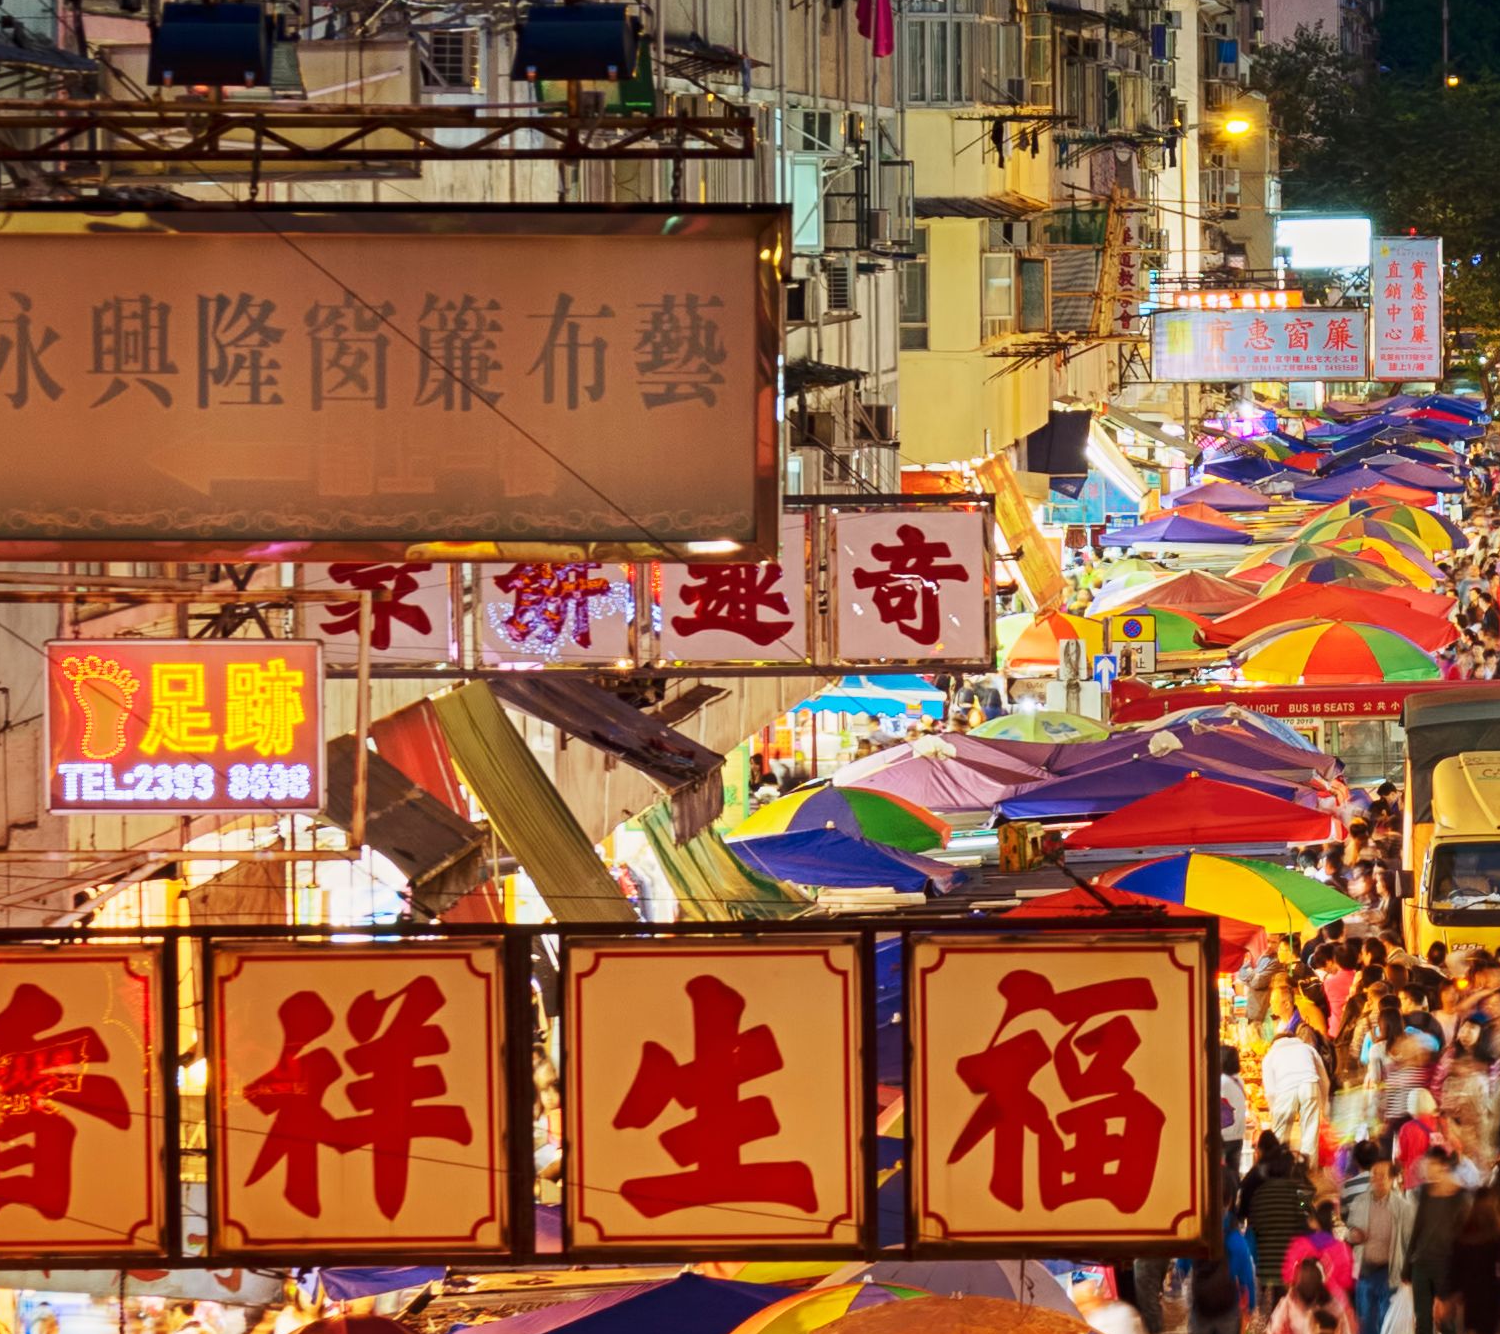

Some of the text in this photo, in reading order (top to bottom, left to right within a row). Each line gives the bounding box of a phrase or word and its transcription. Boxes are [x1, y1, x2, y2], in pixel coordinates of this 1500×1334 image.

[139, 658, 306, 756] 足跡
[1289, 703, 1308, 713] BUS
[1311, 703, 1321, 713] 16
[1323, 703, 1355, 713] SEATS
